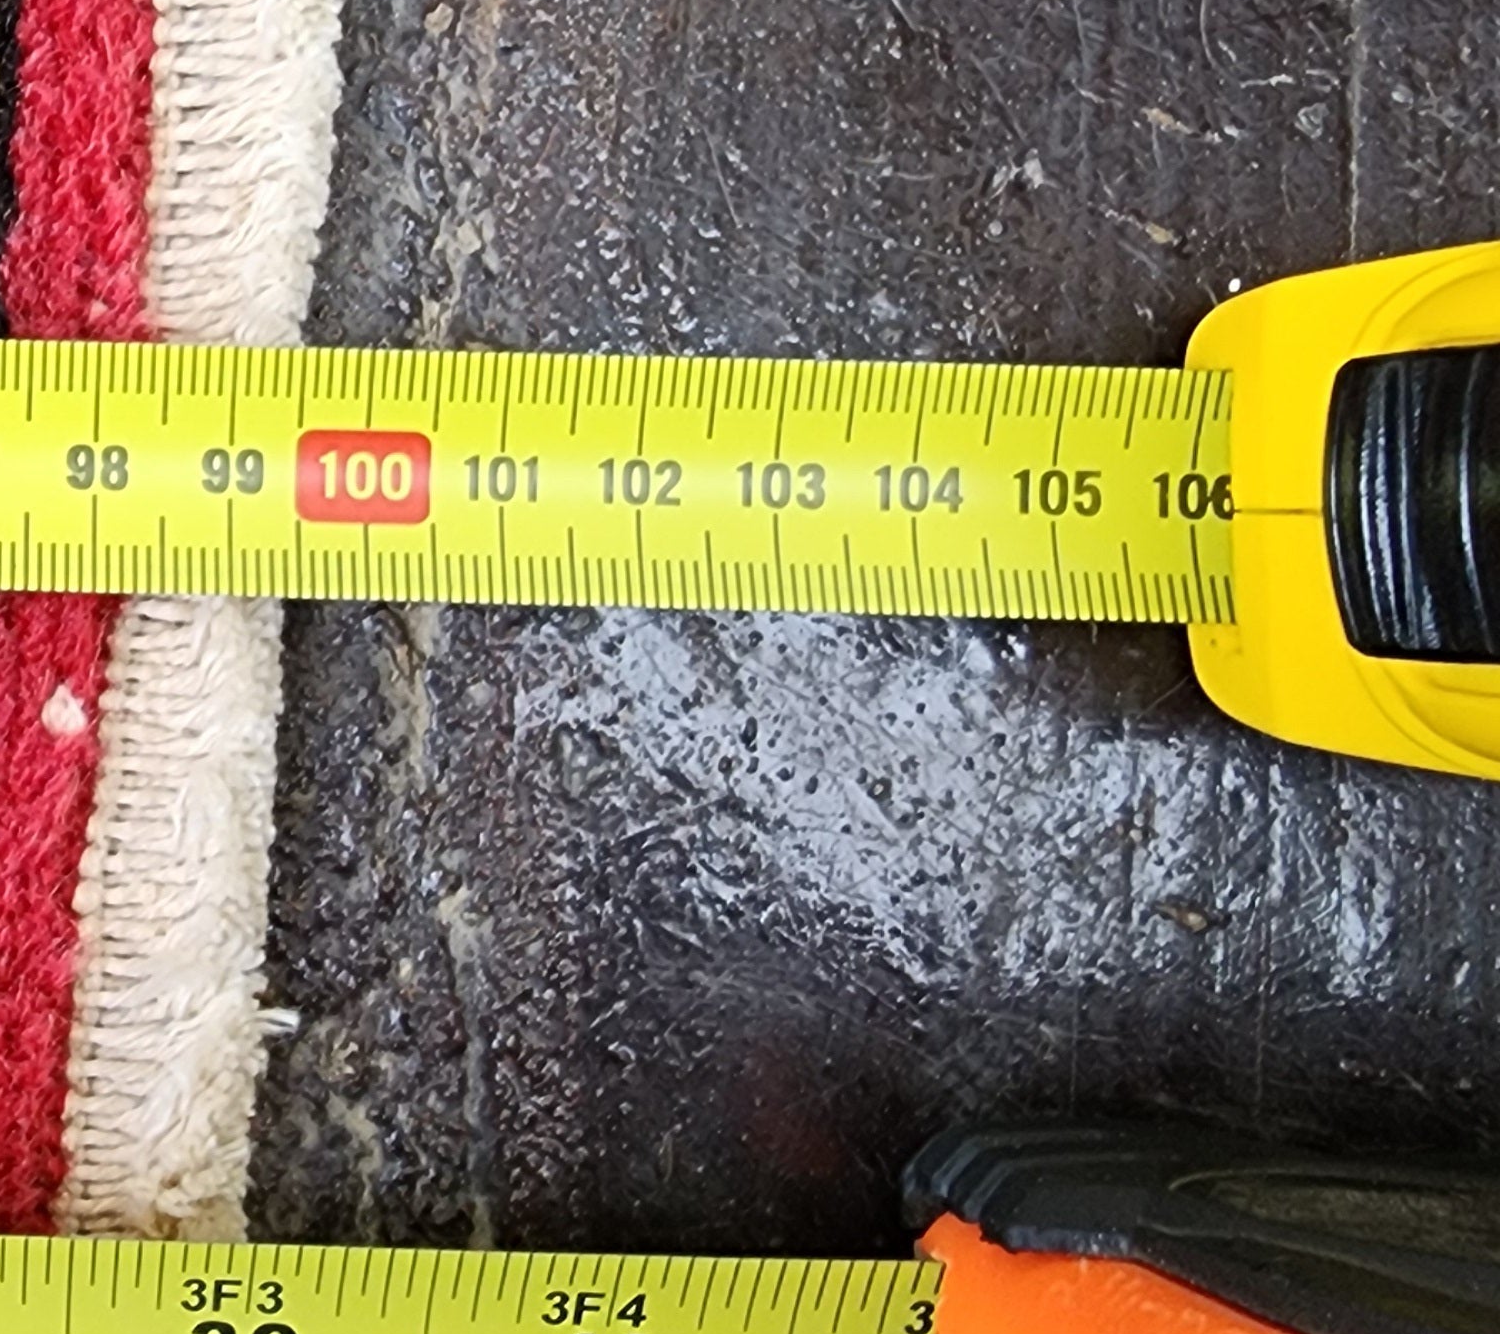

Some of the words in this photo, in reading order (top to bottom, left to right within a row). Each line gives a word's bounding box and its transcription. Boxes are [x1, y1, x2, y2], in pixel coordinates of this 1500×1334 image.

[66, 444, 129, 490] 98
[201, 447, 264, 494] 99
[318, 450, 411, 501] 100
[463, 456, 539, 503] 101
[598, 459, 682, 507] 102
[736, 462, 826, 509] 103
[873, 466, 963, 511] 104
[1013, 468, 1102, 517] 105
[1152, 472, 1234, 520] 106
[180, 1278, 243, 1311] 3F
[256, 1281, 284, 1314] 3
[541, 1291, 606, 1325] 3F
[617, 1293, 648, 1328] 4
